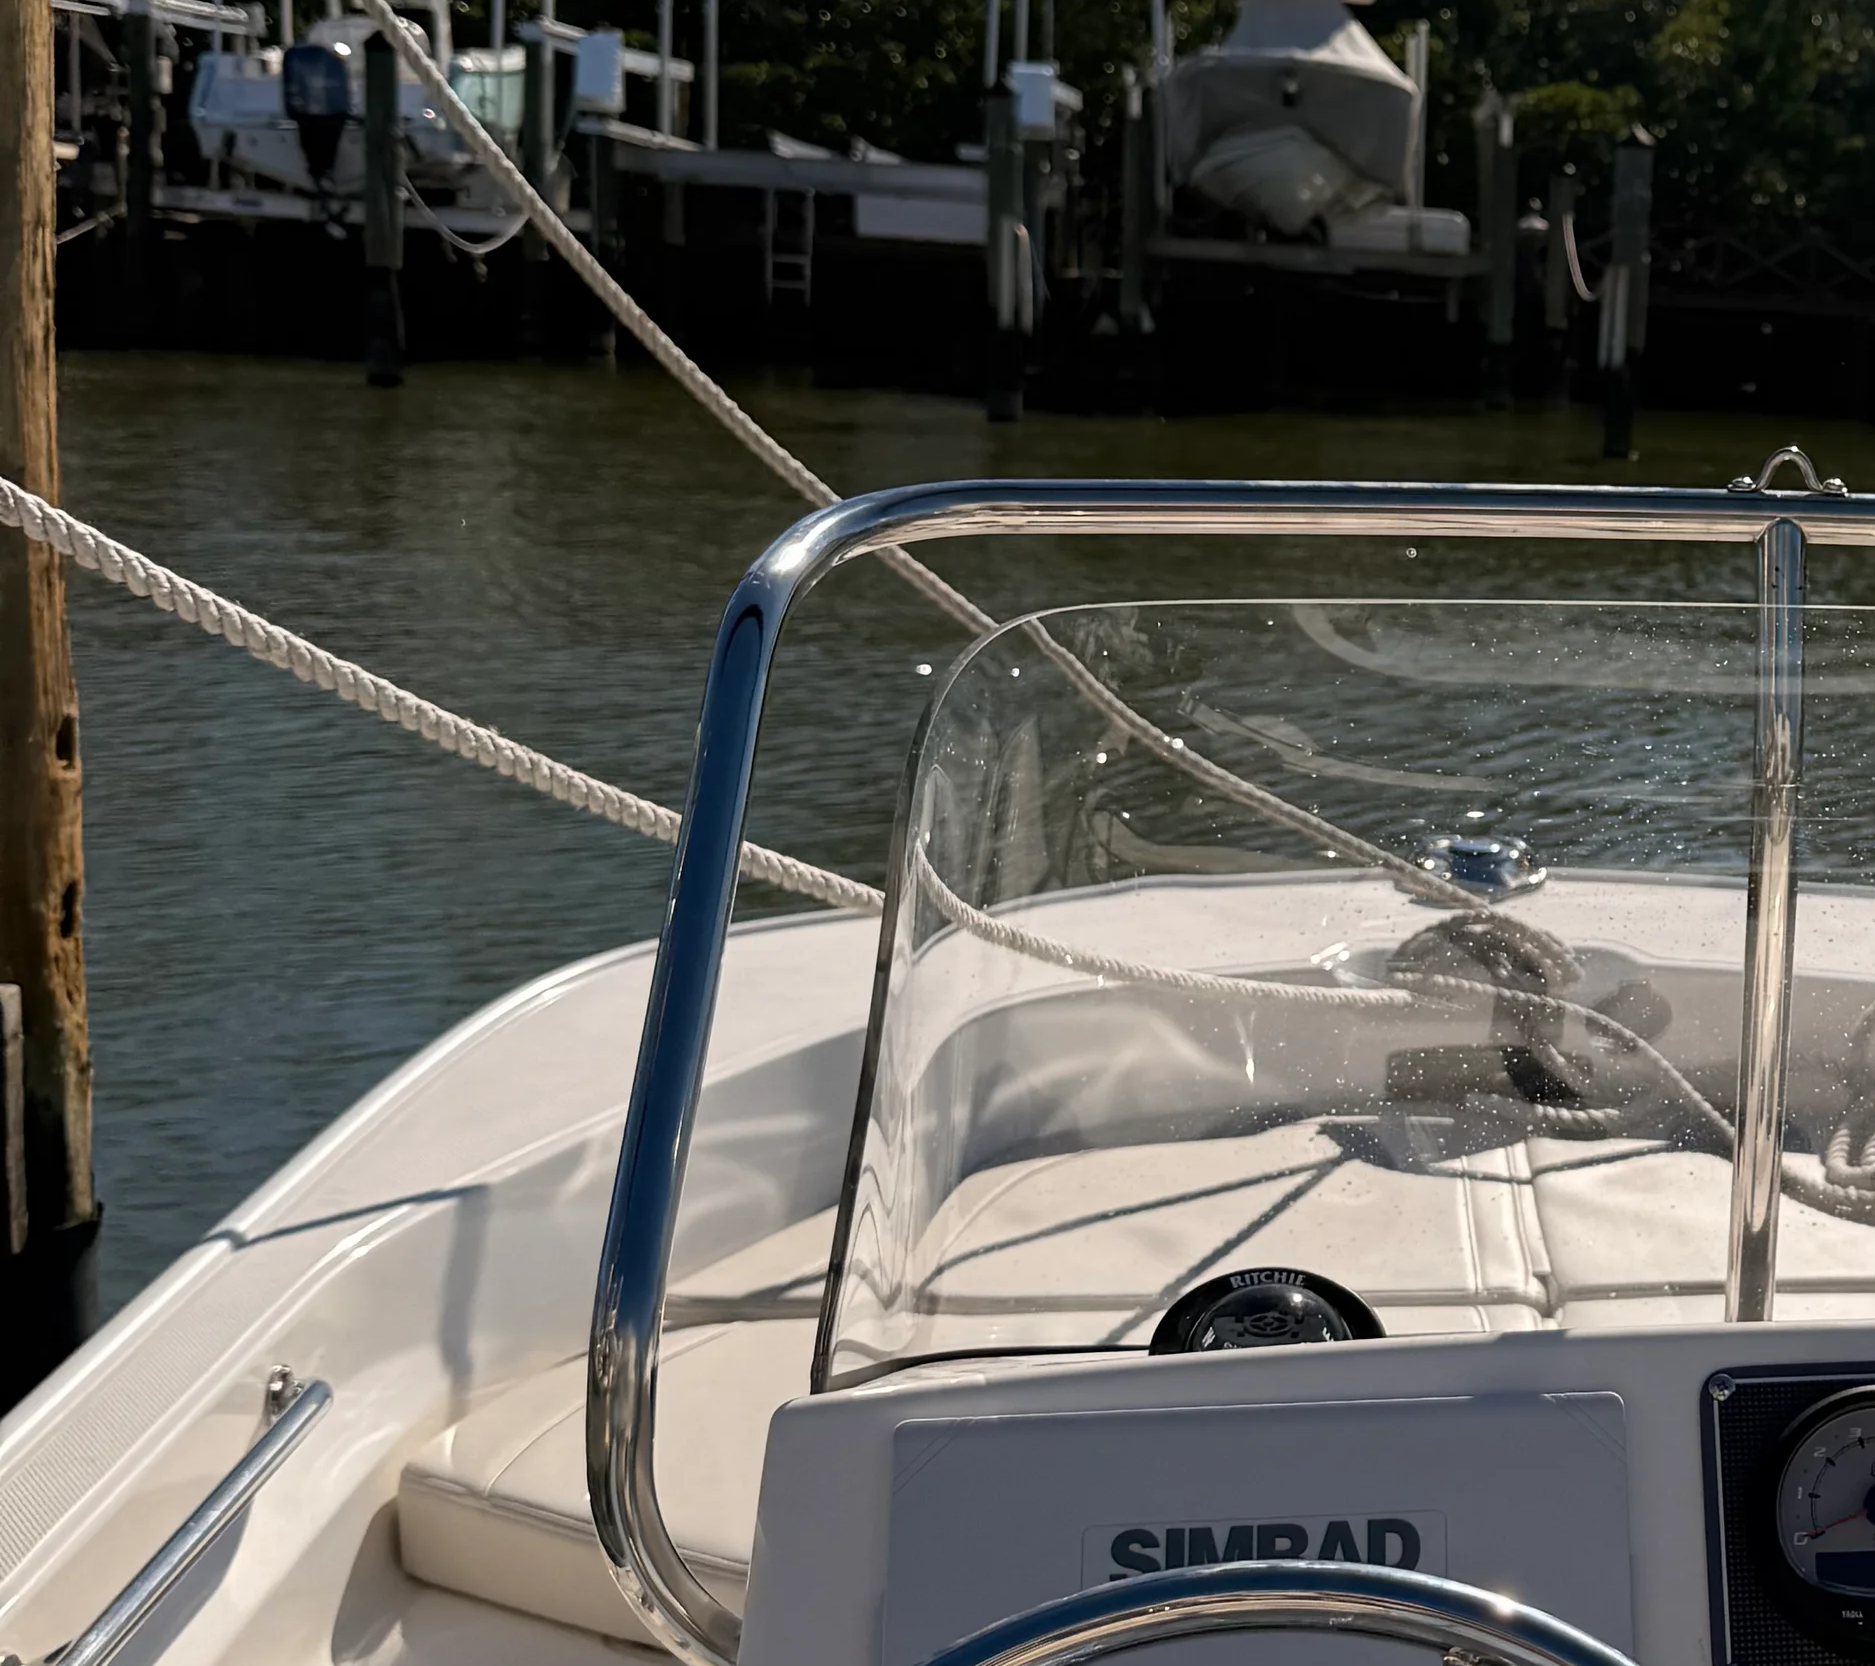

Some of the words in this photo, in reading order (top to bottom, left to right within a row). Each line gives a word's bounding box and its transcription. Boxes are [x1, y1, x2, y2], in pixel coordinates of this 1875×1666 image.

[1230, 1271, 1306, 1289] RITCHIE
[1849, 1428, 1862, 1437] 3
[1814, 1447, 1825, 1457] 2
